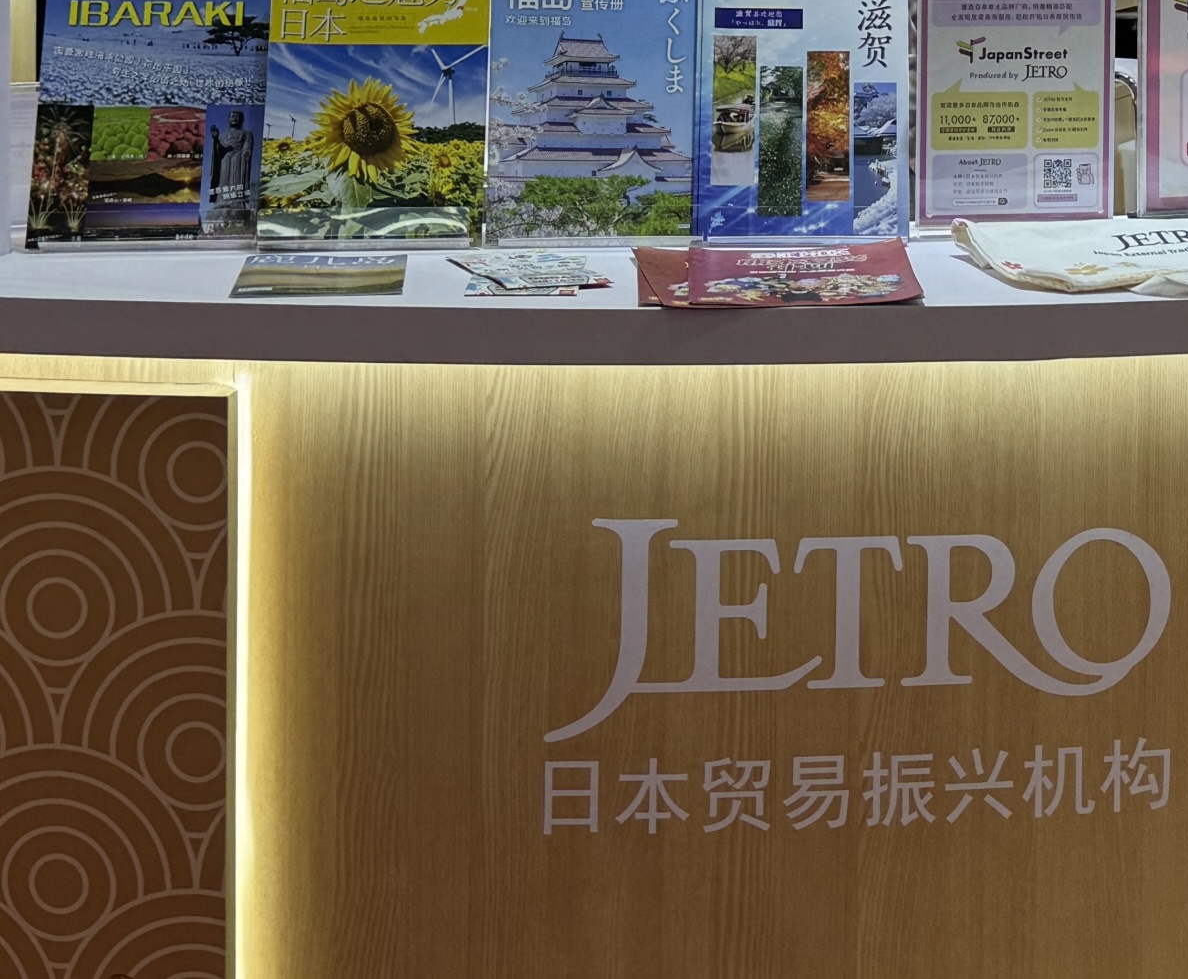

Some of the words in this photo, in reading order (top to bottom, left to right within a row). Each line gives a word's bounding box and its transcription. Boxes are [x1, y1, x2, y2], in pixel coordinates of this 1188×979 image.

[68, 0, 245, 27] IBARAKI
[281, 7, 348, 43] 日本
[505, 15, 572, 26] 欢迎来到福岛
[978, 46, 1068, 63] JapanStreet
[969, 71, 1006, 80] Produced
[1008, 71, 1019, 81] by
[1021, 63, 1068, 82] JETRO
[958, 158, 978, 166] About
[979, 157, 1002, 167] JETRO
[543, 517, 1171, 743] JETRO
[541, 736, 1172, 836] 日本贸易振兴机构
